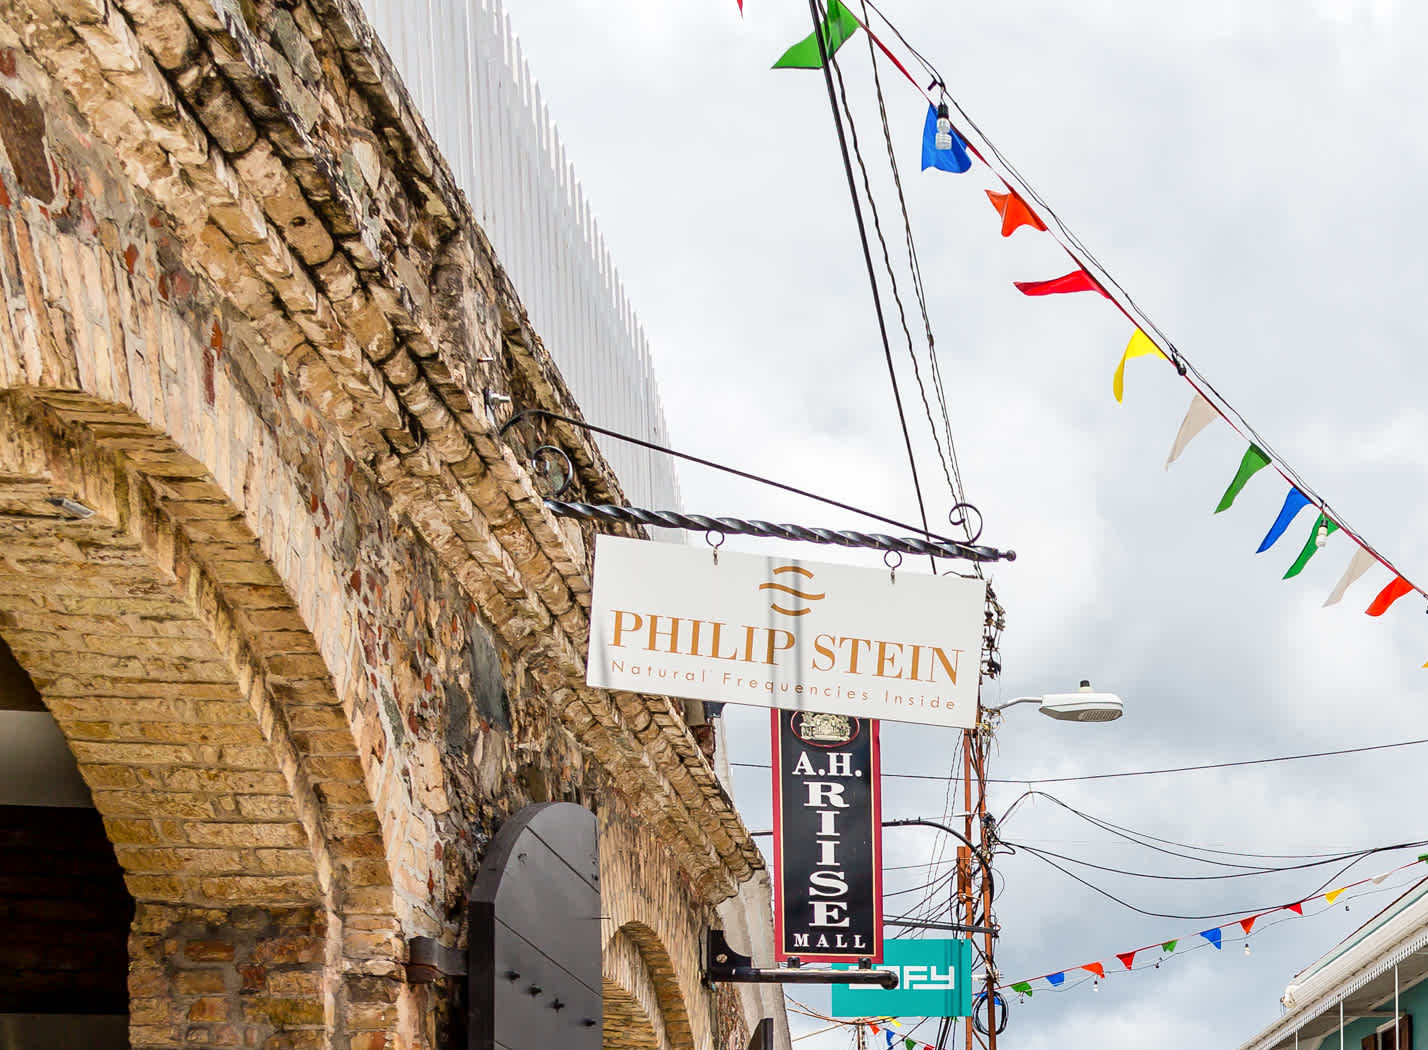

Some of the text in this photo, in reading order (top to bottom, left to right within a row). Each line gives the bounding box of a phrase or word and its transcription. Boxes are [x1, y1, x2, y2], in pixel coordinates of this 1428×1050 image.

[608, 609, 964, 686] PHILIP STEIN
[611, 660, 955, 711] Natural Frequencies Inside
[792, 751, 862, 777] A.H.
[803, 781, 850, 928] RIISE
[793, 933, 866, 949] MALL
[849, 965, 955, 990] FY
